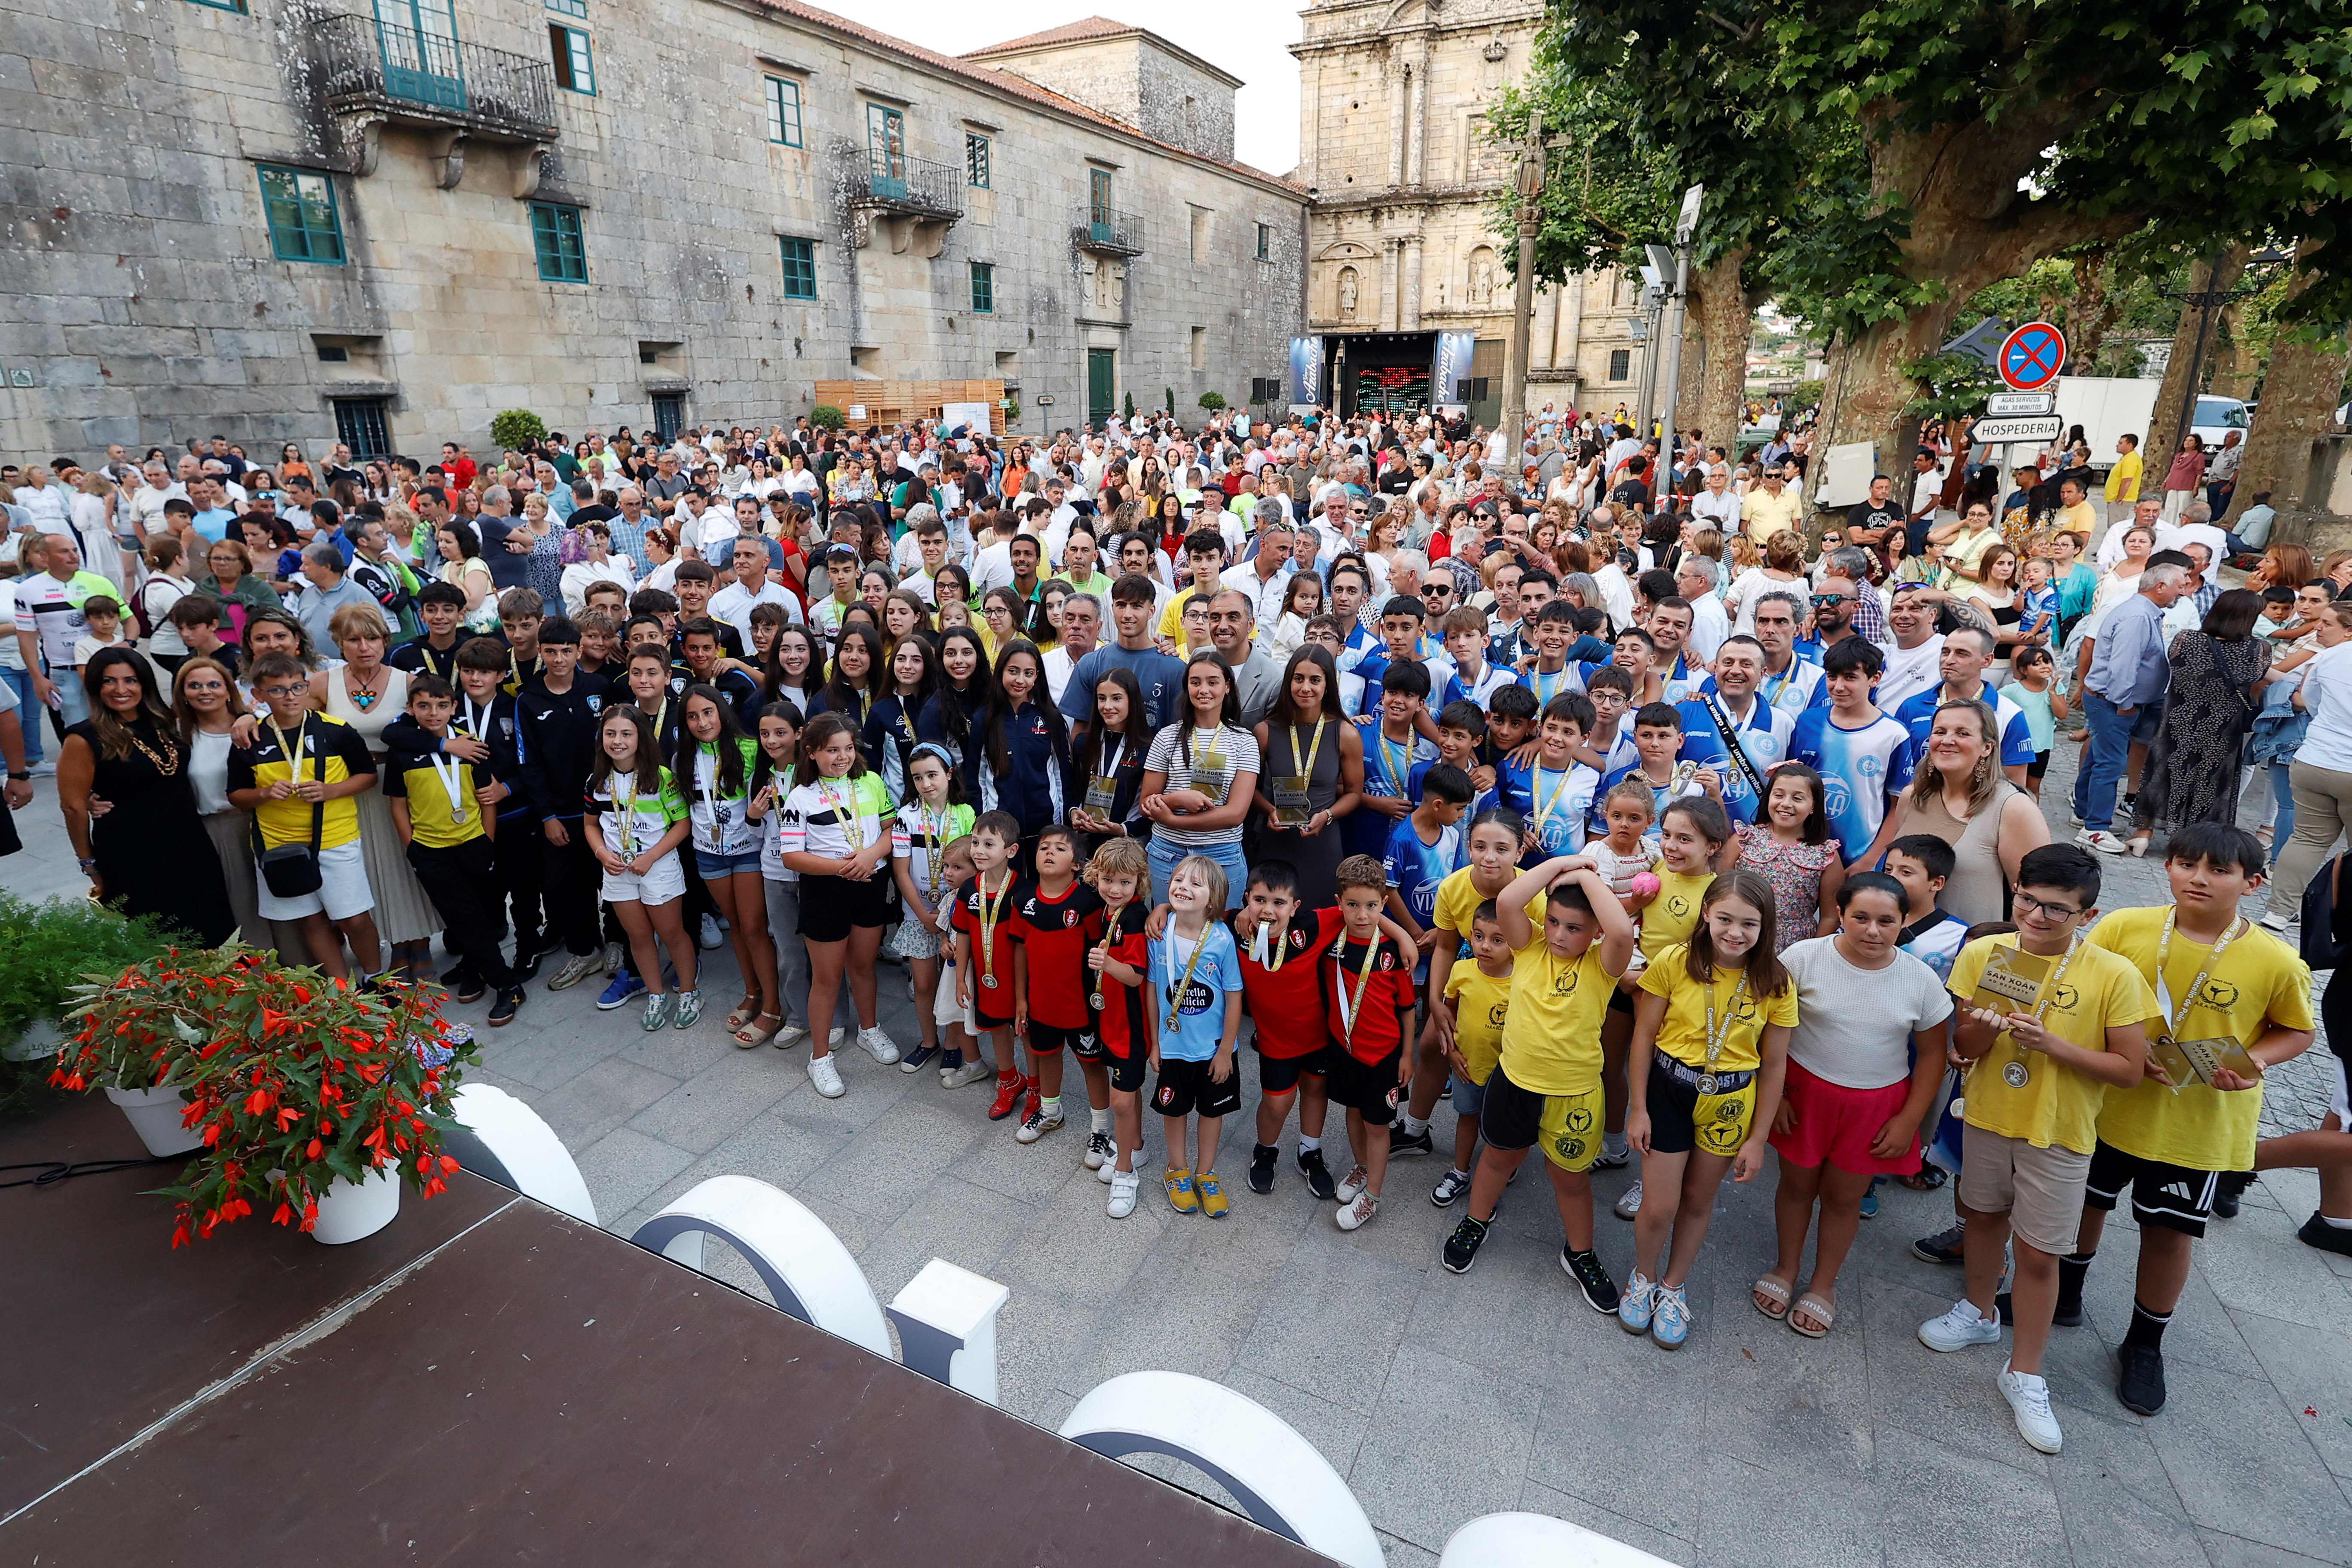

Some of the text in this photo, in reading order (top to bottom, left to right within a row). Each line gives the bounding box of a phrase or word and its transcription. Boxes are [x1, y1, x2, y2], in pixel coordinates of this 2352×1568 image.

[1303, 336, 1318, 403] Azabache
[1438, 332, 1456, 403] Azabache
[1982, 423, 2055, 436] HOSPEDERIA
[1152, 683, 1163, 697] 3
[1709, 704, 1724, 726] umbro
[1733, 748, 1762, 794] umbro umbro
[1000, 869, 1011, 891] Concello
[2161, 931, 2170, 945] Poio
[2223, 931, 2233, 940] de
[1193, 941, 1202, 953] Poio
[2214, 940, 2229, 953] Poio
[1366, 952, 1374, 965] Poio
[2061, 957, 2070, 966] de
[1181, 968, 1191, 989] Concello
[1986, 970, 2006, 981] SAN
[2053, 965, 2066, 980] Poio
[1174, 984, 1207, 997] Erella
[1354, 982, 1365, 1004] Concello
[1736, 979, 1746, 993] Poio
[1182, 997, 1205, 1006] alicia
[2176, 971, 2208, 1022] Concello de Poio
[2035, 999, 2049, 1019] Conce
[1718, 1012, 1733, 1038] Concello
[1710, 1047, 1720, 1061] Poio
[2196, 1043, 2218, 1070] SAN XO
[1718, 1073, 1736, 1088] AST
[1800, 1299, 1833, 1321] umbro
